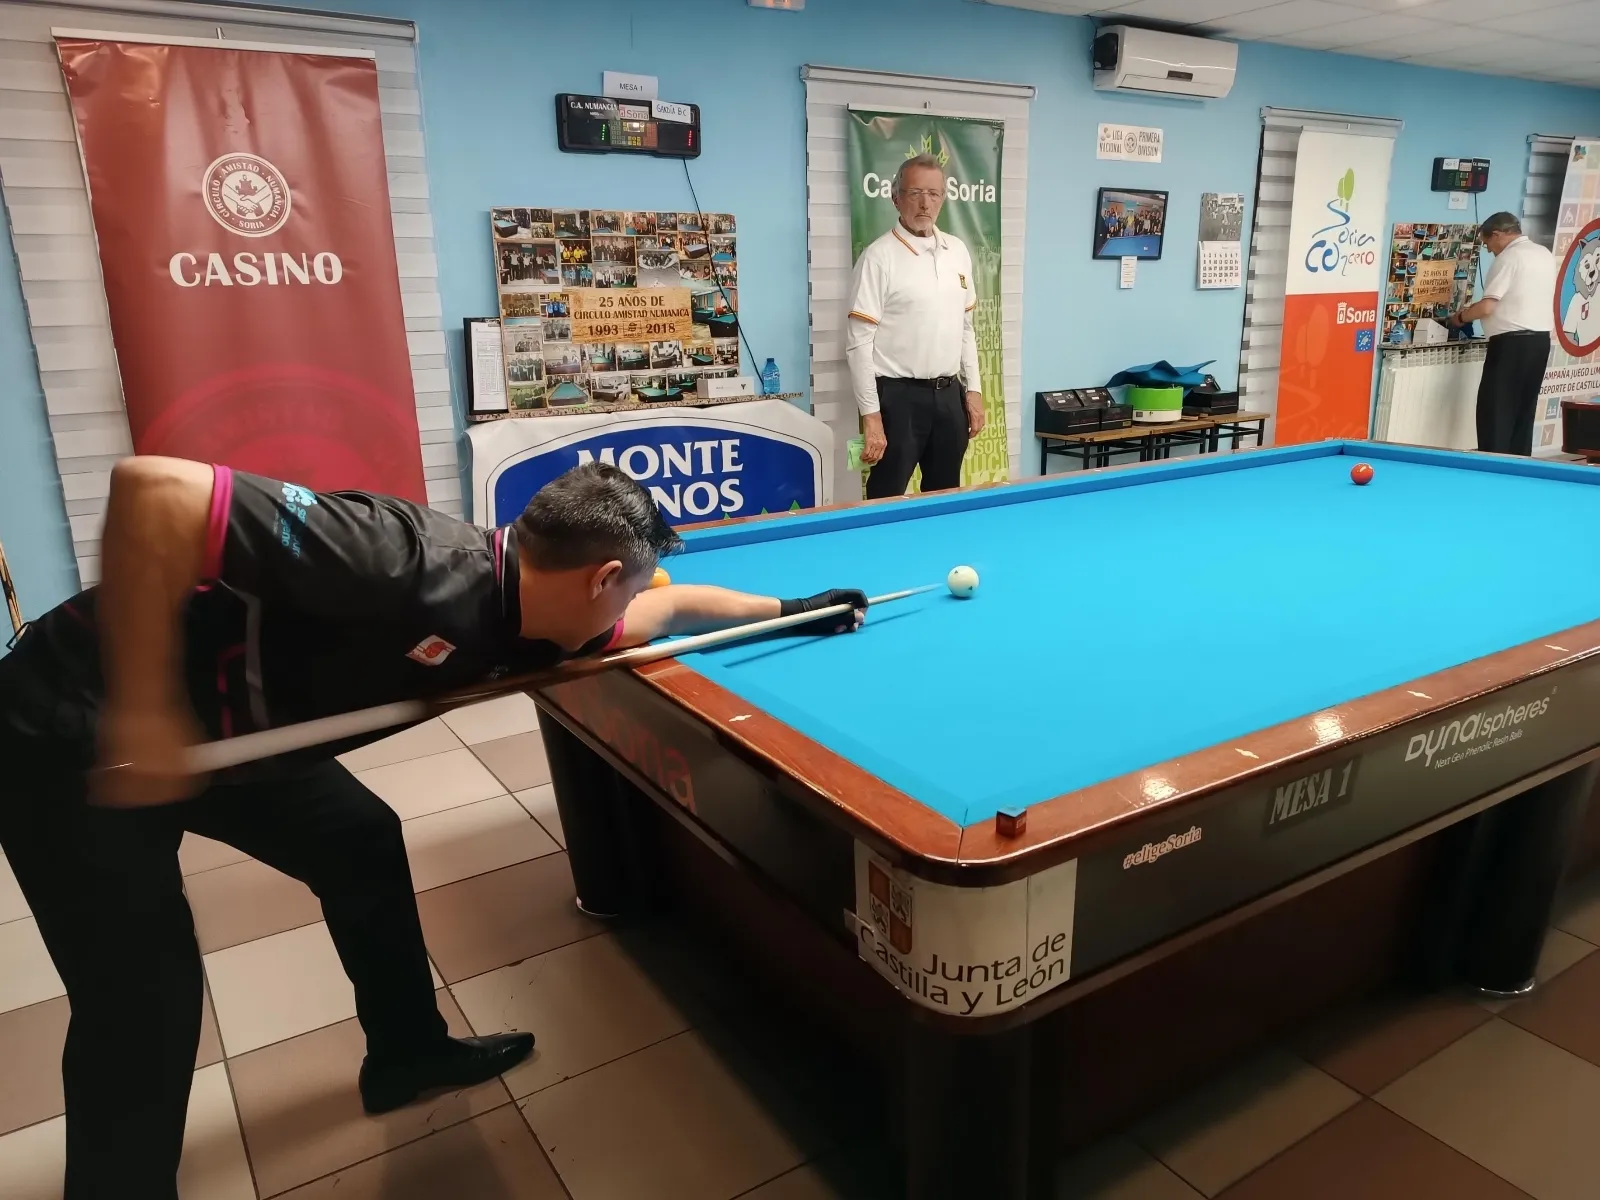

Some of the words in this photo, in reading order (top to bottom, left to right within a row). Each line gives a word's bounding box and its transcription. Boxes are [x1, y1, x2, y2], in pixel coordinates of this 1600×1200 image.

[620, 82, 638, 91] MESA
[220, 161, 260, 177] AMISTAD
[265, 174, 282, 219] NUMANCIA
[946, 176, 997, 203] Soria
[238, 219, 265, 230] SORIA
[168, 251, 344, 288] CASINO
[599, 296, 614, 308] 25
[618, 293, 647, 308] AÑOS
[650, 295, 665, 307] DE
[612, 309, 648, 319] AMISTAD
[588, 324, 619, 336] 1993
[645, 322, 676, 335] 2018
[1544, 368, 1570, 380] AMPAÑA
[1570, 367, 1589, 379] JUEGO
[1567, 383, 1575, 391] DE
[647, 478, 744, 518] NOS
[1268, 768, 1333, 825] MESA
[1337, 759, 1355, 798] 1
[1123, 825, 1202, 870] #eligeSoria
[923, 954, 1021, 983] Junta
[1032, 932, 1066, 963] de
[860, 925, 948, 1006] Castilla
[959, 991, 984, 1015] y
[996, 958, 1064, 1006] León
